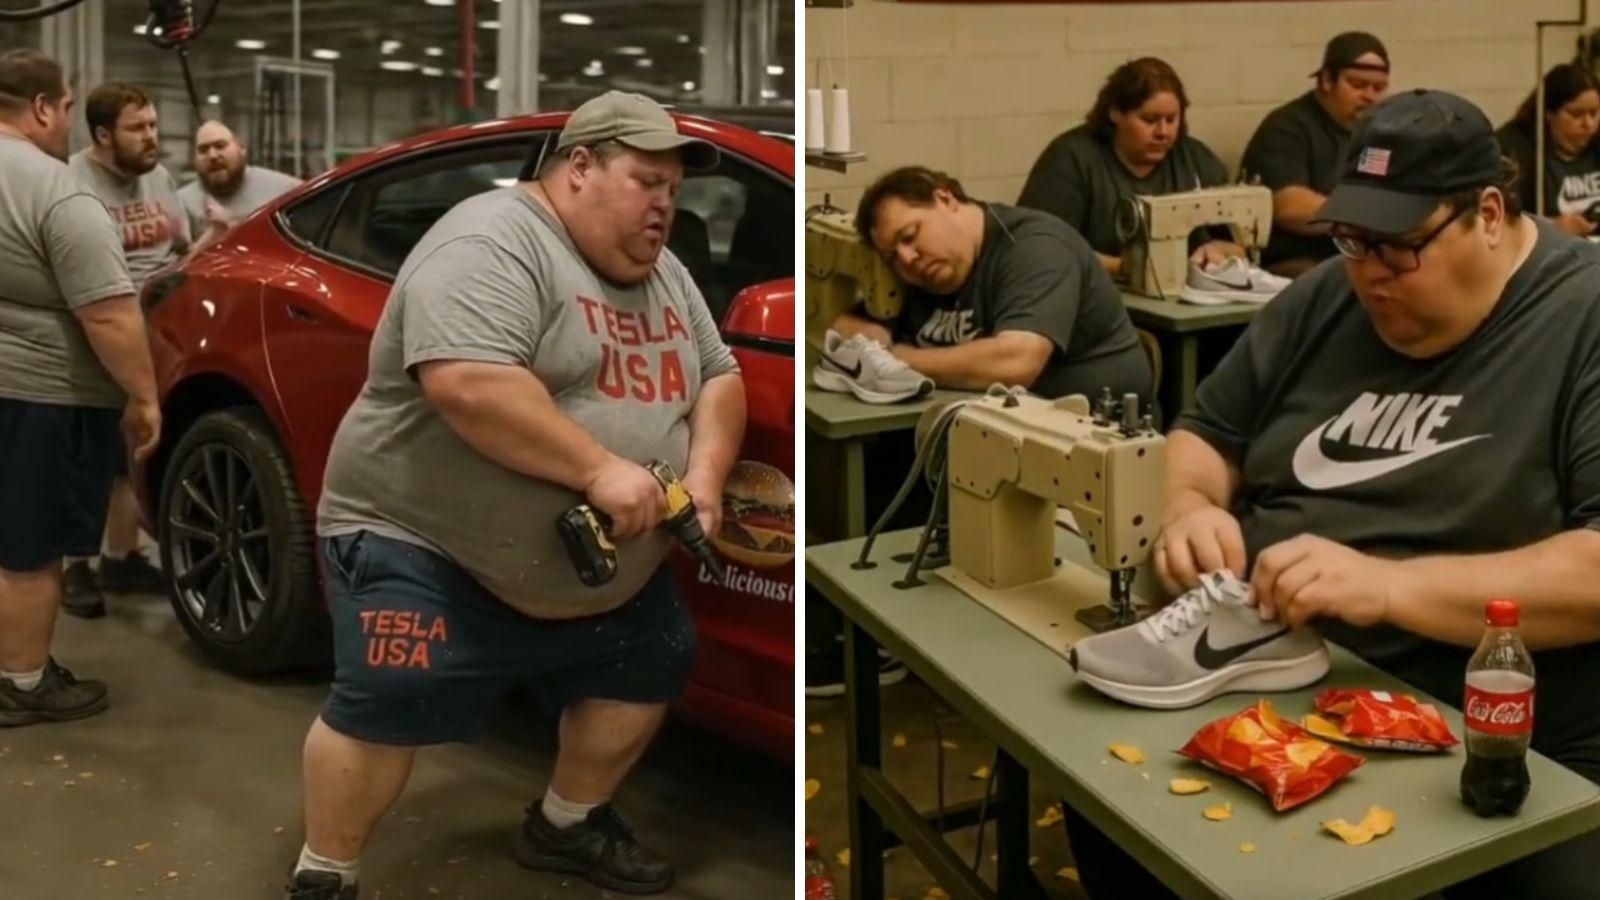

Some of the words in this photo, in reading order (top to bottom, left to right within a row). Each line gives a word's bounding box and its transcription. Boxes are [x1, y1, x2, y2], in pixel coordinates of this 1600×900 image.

[576, 295, 689, 346] TESLA
[597, 343, 686, 402] USA
[1324, 391, 1463, 452] NIKE
[698, 563, 795, 602] Dlicious
[359, 609, 447, 642] TESLA
[367, 637, 430, 669] USA
